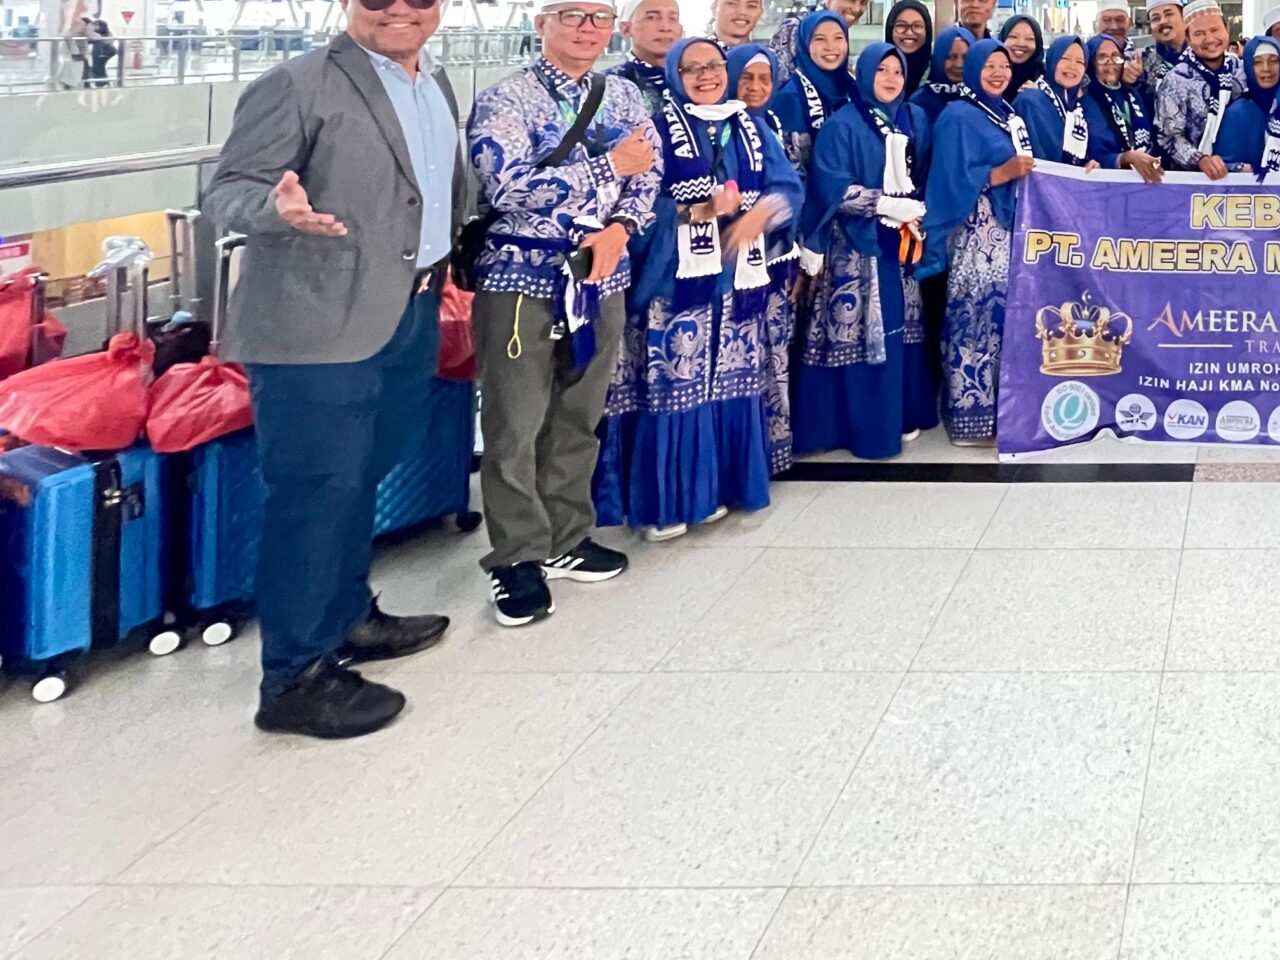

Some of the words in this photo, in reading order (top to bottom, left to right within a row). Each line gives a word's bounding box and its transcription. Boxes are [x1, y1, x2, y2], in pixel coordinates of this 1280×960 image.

[1024, 229, 1084, 268] PT.
[1090, 238, 1258, 275] AMEERA
[1147, 299, 1279, 338] AMEERA
[1189, 362, 1220, 374] IZIN
[1139, 376, 1170, 389] IZIN
[1176, 379, 1213, 391] HAJI
[1219, 380, 1254, 391] KMA
[1177, 414, 1206, 426] KAN
